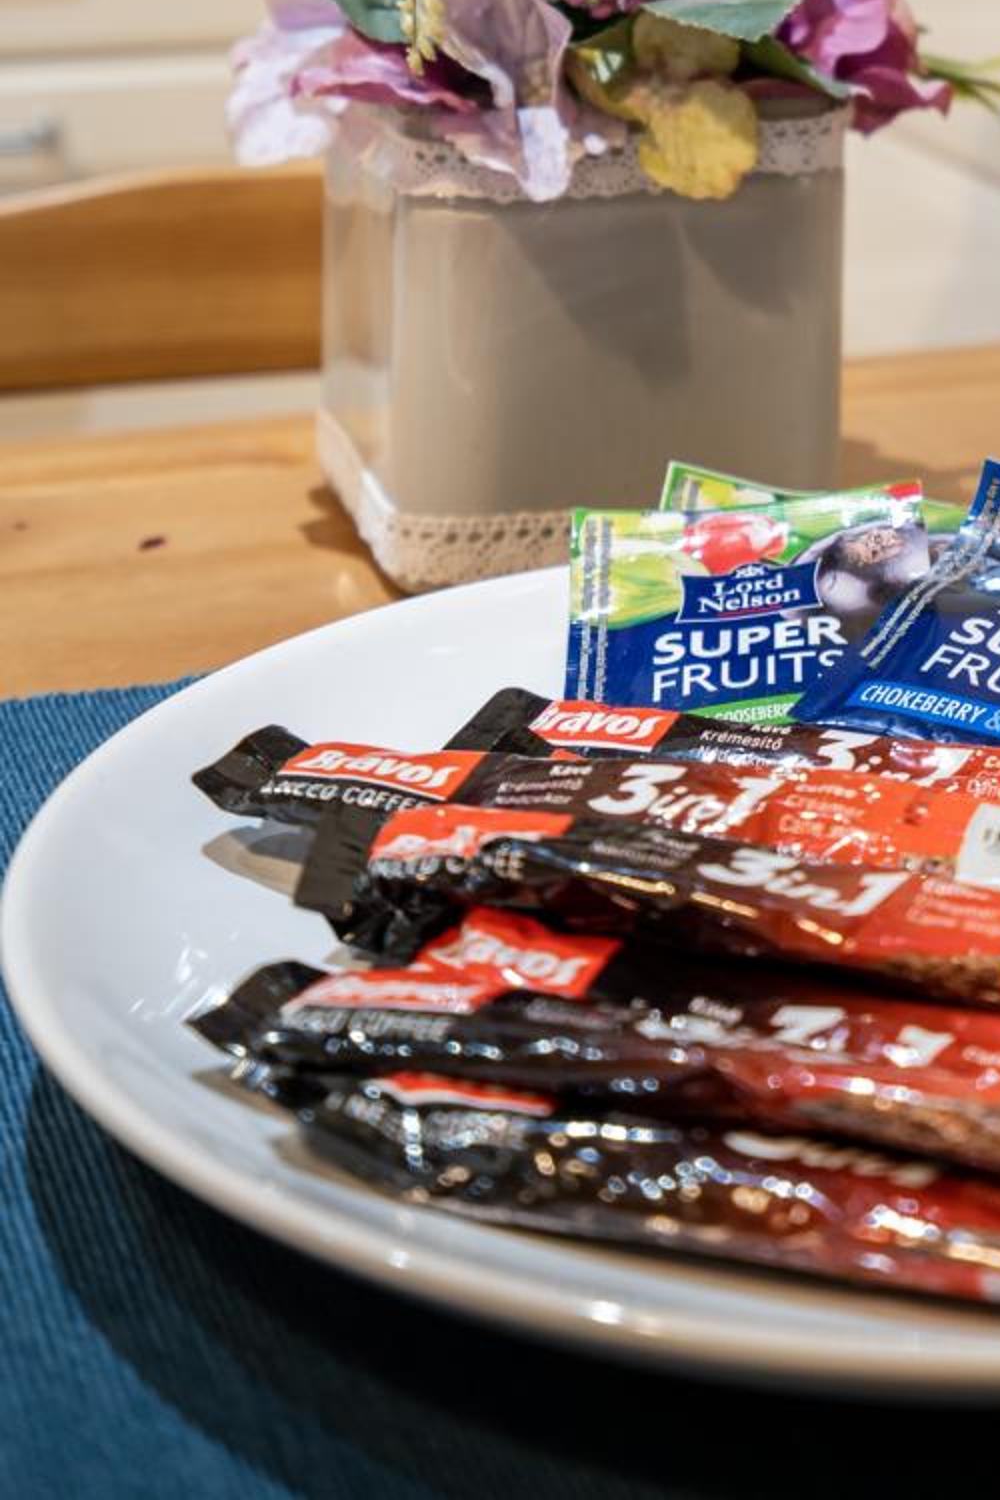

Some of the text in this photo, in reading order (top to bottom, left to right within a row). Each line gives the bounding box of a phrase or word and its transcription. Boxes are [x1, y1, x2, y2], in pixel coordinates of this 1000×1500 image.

[697, 586, 801, 614] Nelson
[713, 576, 784, 599] Lord
[652, 616, 848, 666] SUPER
[860, 684, 986, 724] CHOKEBERRY
[296, 750, 461, 789] Bravos
